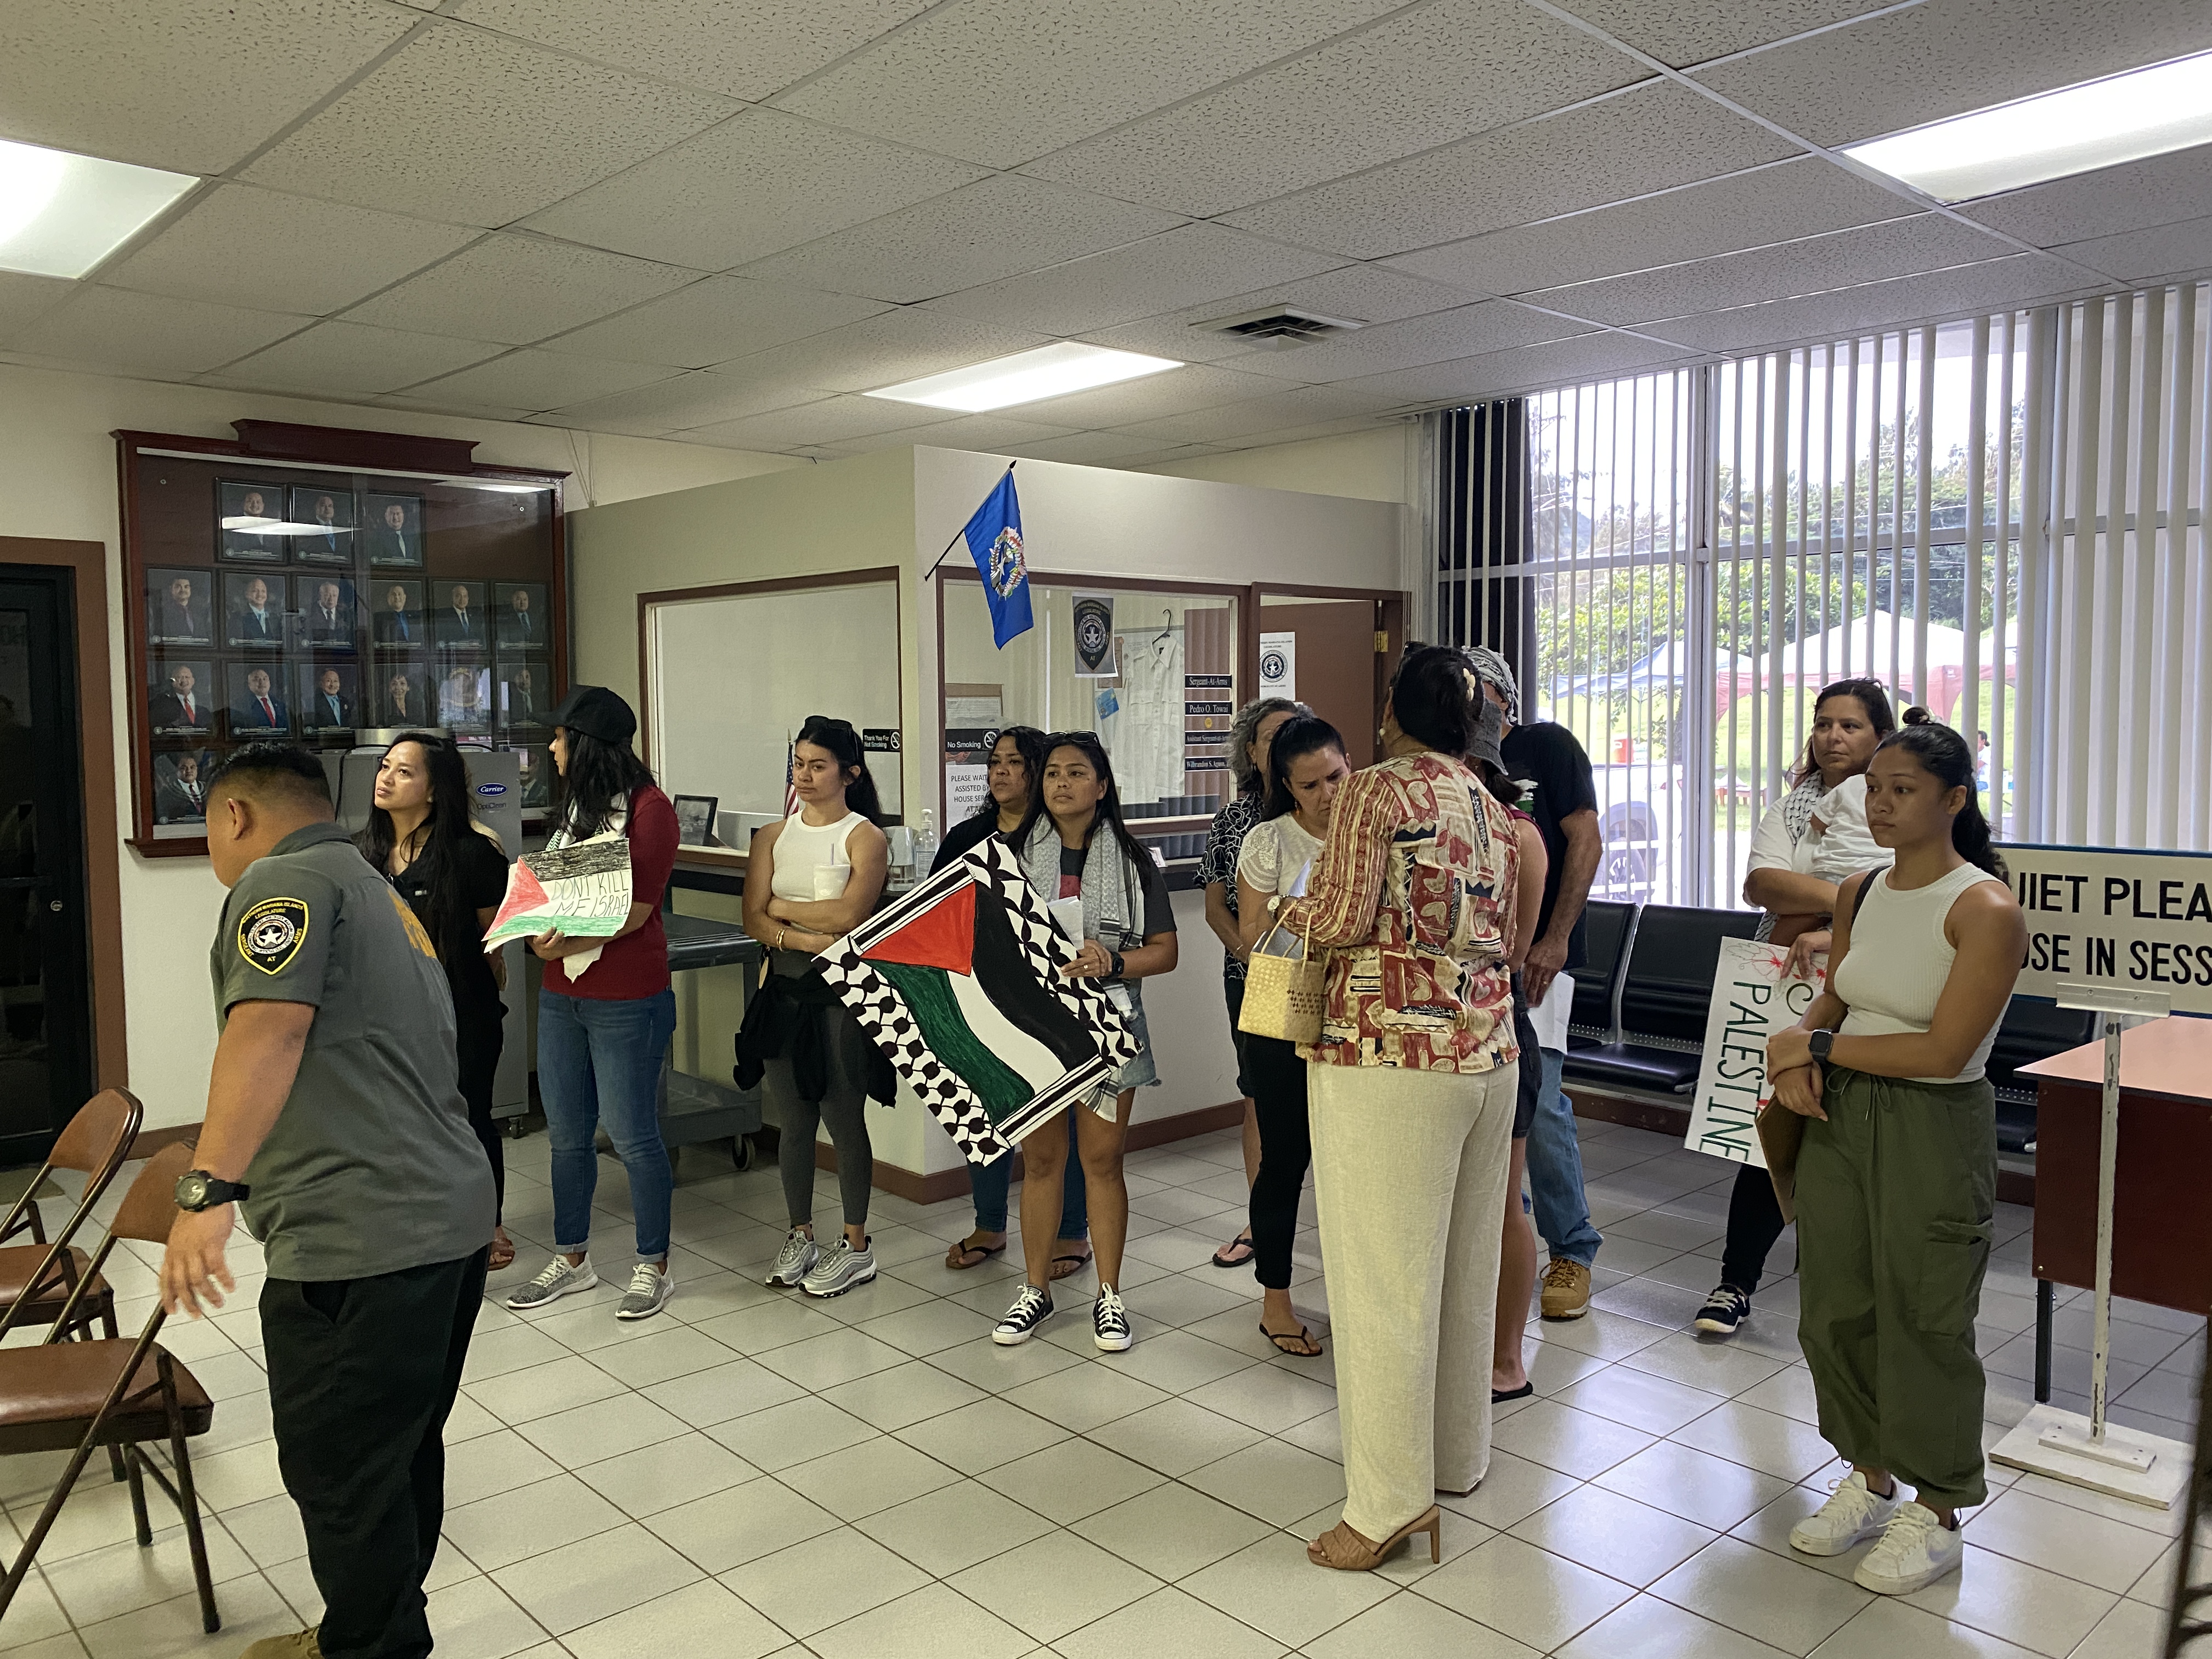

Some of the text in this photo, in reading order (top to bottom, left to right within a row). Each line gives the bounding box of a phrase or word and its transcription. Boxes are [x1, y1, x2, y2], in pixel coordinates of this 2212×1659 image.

[1189, 704, 1204, 713] Pedro
[1205, 704, 1212, 713] O.
[956, 741, 981, 749] Smoking
[597, 871, 629, 895] KILL
[554, 892, 629, 917] ME ISRAEL
[2104, 877, 2212, 923] PLEA
[2086, 937, 2115, 977] IN
[2129, 940, 2212, 986] SESS
[1700, 981, 1771, 1162] PALESTINE
